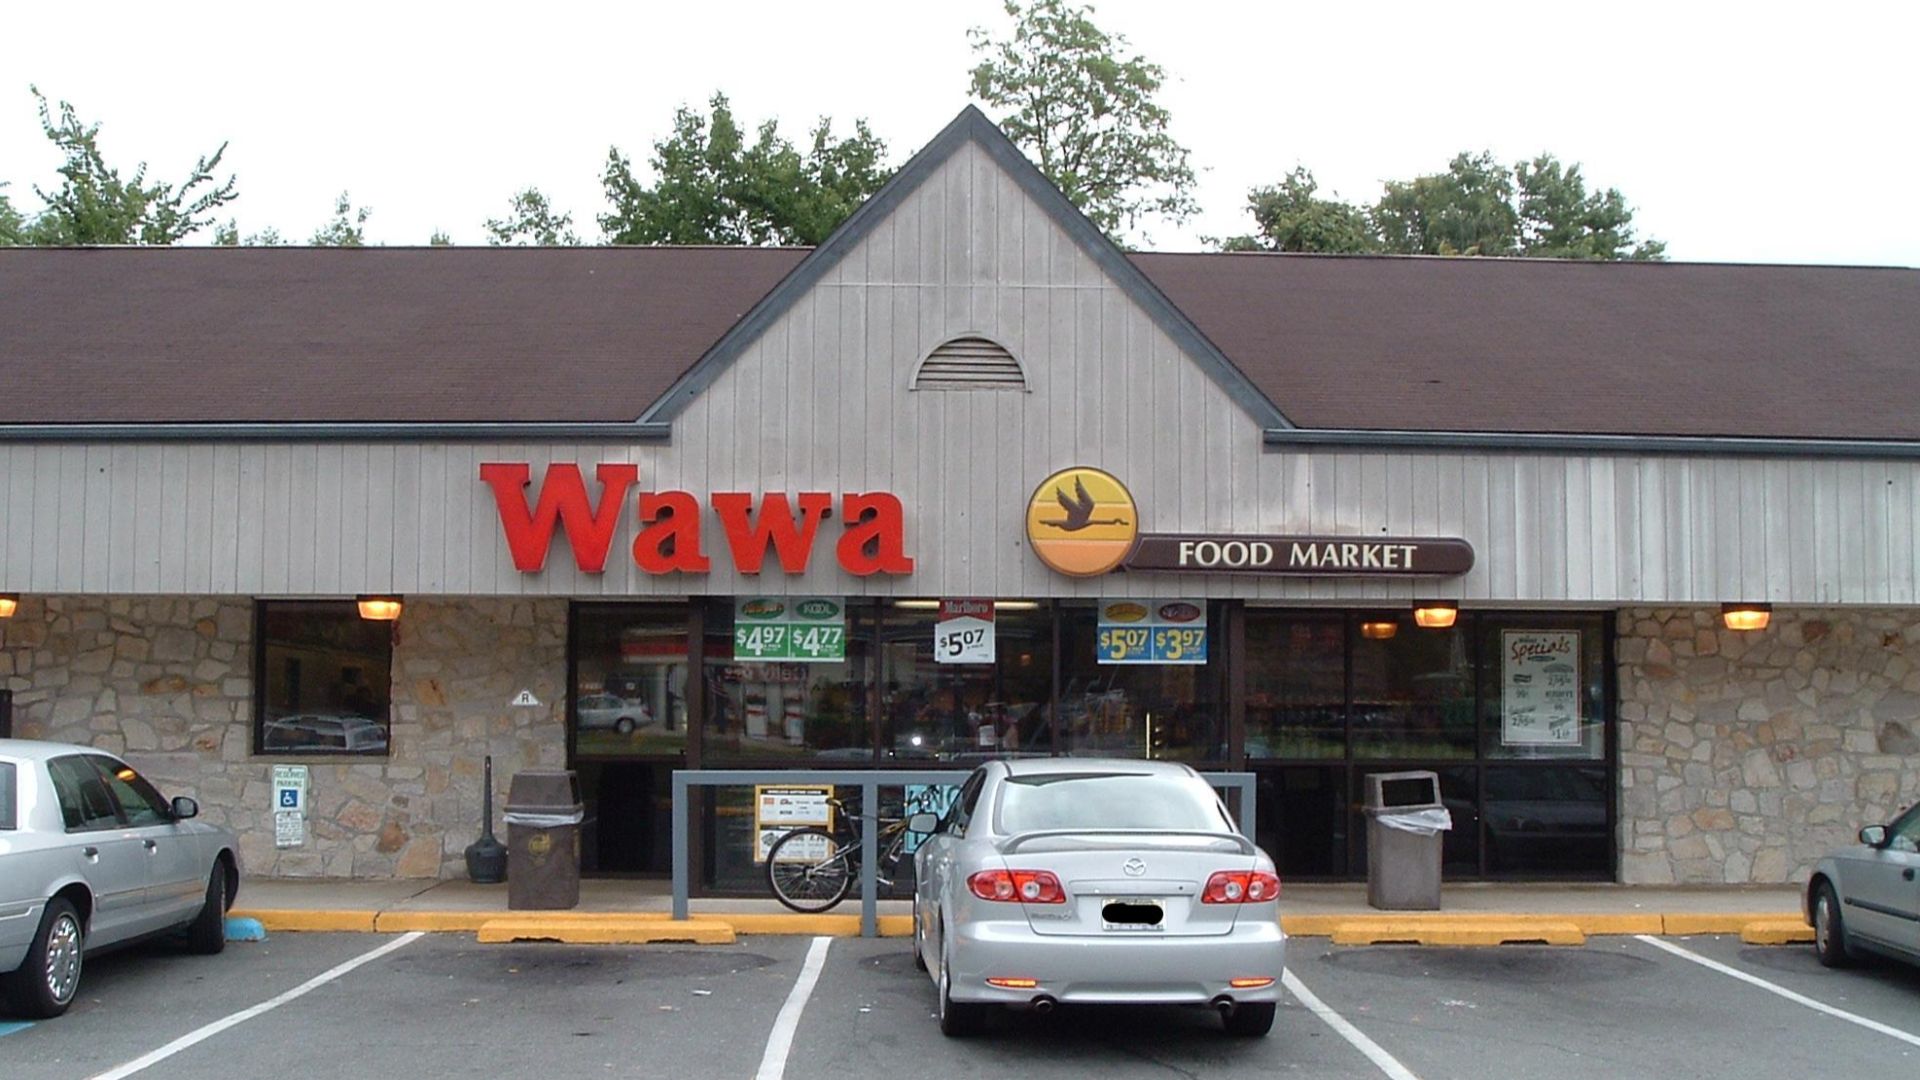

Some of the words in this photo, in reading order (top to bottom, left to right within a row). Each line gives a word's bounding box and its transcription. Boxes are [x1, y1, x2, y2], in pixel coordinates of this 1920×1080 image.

[480, 463, 914, 576] Wawa
[1178, 541, 1274, 567] FOOD
[1289, 543, 1417, 569] MARKET
[803, 603, 833, 614] KOOL
[1511, 636, 1571, 666] Specials
[521, 693, 529, 703] R
